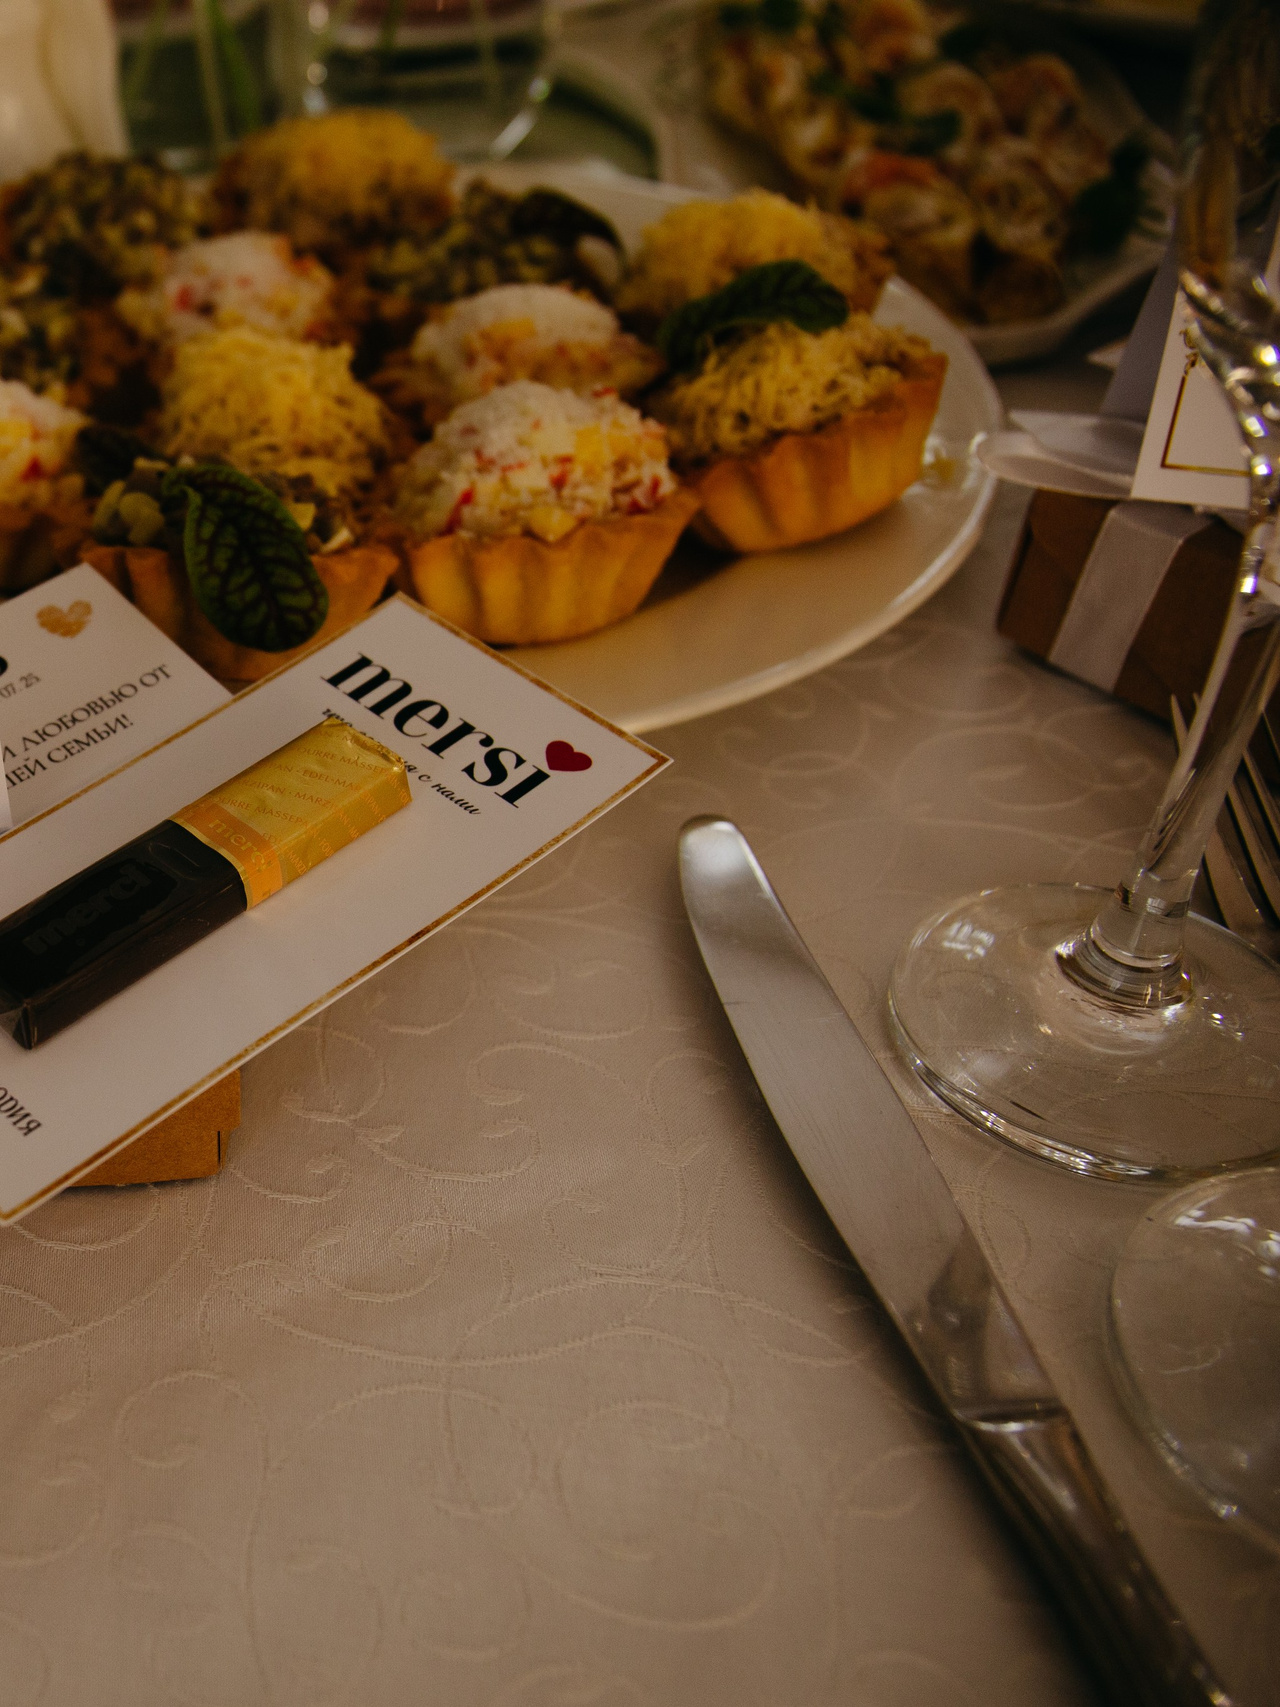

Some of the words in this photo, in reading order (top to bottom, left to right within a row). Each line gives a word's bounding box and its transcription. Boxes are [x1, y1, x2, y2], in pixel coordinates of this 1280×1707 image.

[22, 683, 139, 752] ЛЮБОВЬЮ
[138, 664, 173, 689] ОТ
[47, 713, 134, 764] СЕМЬИ!
[320, 652, 551, 809] mersi
[430, 782, 482, 816] нами
